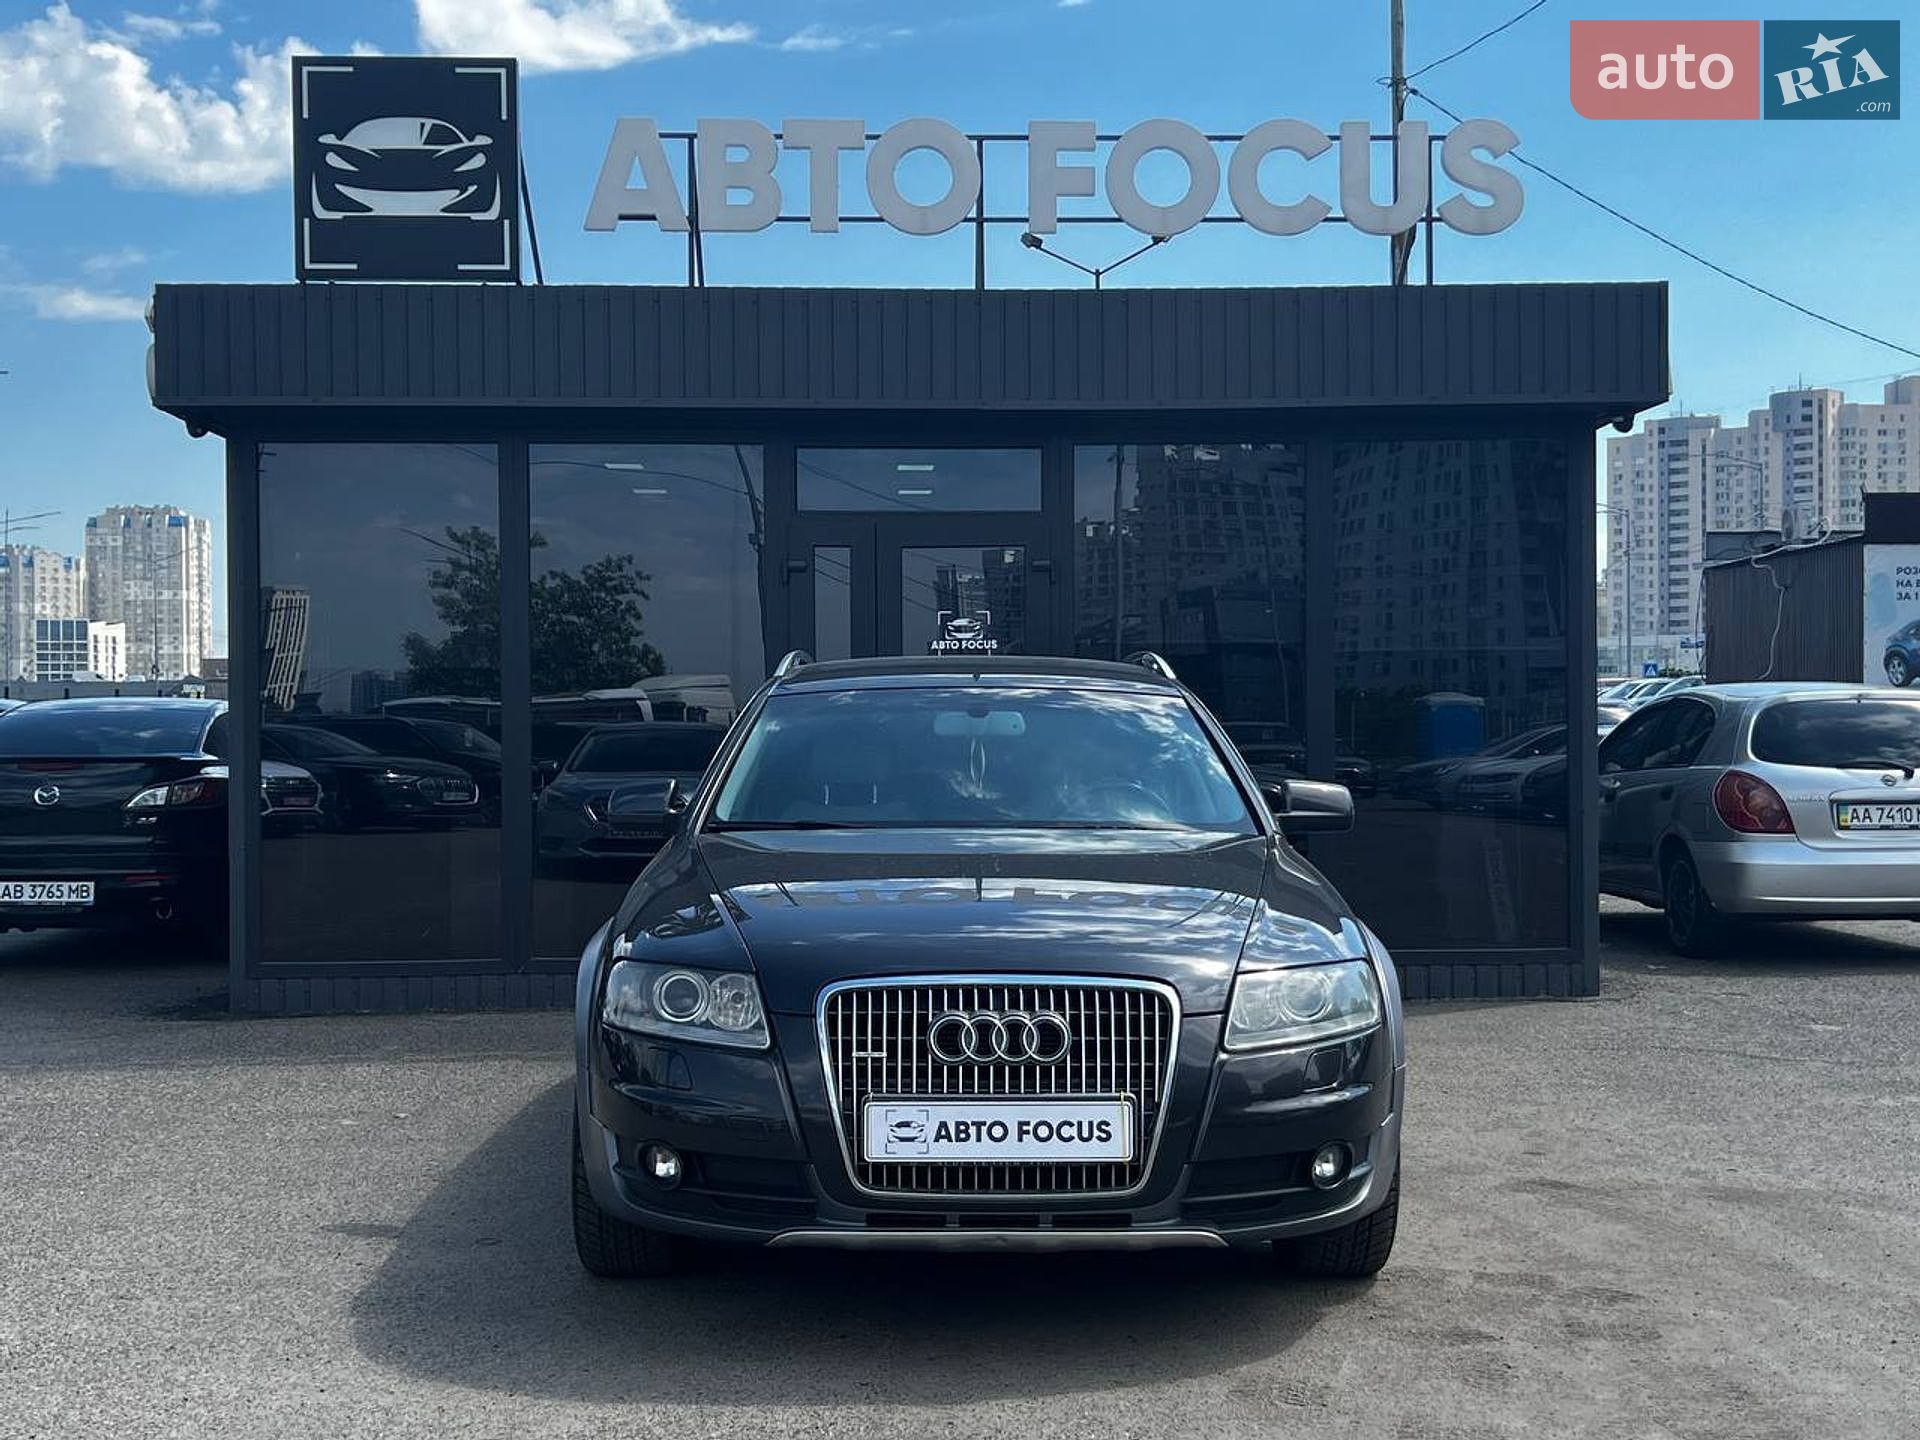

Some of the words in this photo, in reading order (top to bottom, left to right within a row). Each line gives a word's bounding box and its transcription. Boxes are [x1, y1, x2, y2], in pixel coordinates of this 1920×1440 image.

[583, 117, 981, 236] АВТО
[1028, 117, 1526, 236] FOCUS
[1896, 566, 1920, 576] РОЗ
[931, 640, 960, 650] АВТО
[961, 639, 998, 650] FOCUS
[1850, 807, 1872, 823] AA
[1876, 807, 1913, 823] 7410
[1, 884, 24, 899] AB
[28, 884, 64, 899] 3765
[68, 884, 90, 899] MB
[933, 1120, 1009, 1143] АВТО
[1017, 1120, 1113, 1143] FOCUS
